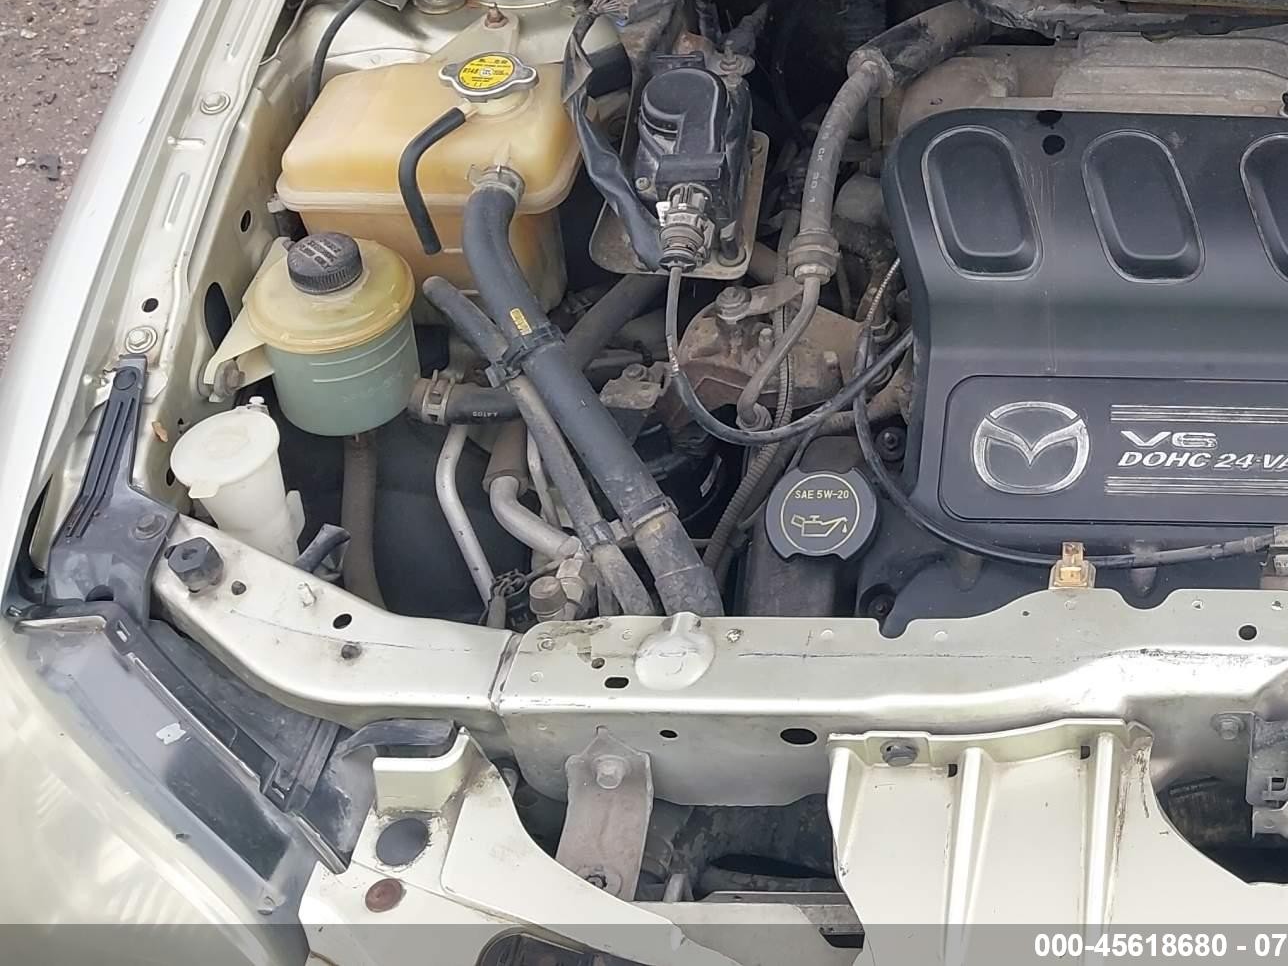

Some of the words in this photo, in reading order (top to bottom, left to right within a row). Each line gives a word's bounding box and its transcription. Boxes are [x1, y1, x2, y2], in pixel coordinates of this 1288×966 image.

[1120, 430, 1217, 449] V6
[1118, 451, 1212, 468] DOHC
[795, 489, 814, 500] SAE
[816, 489, 849, 500] 5W-20
